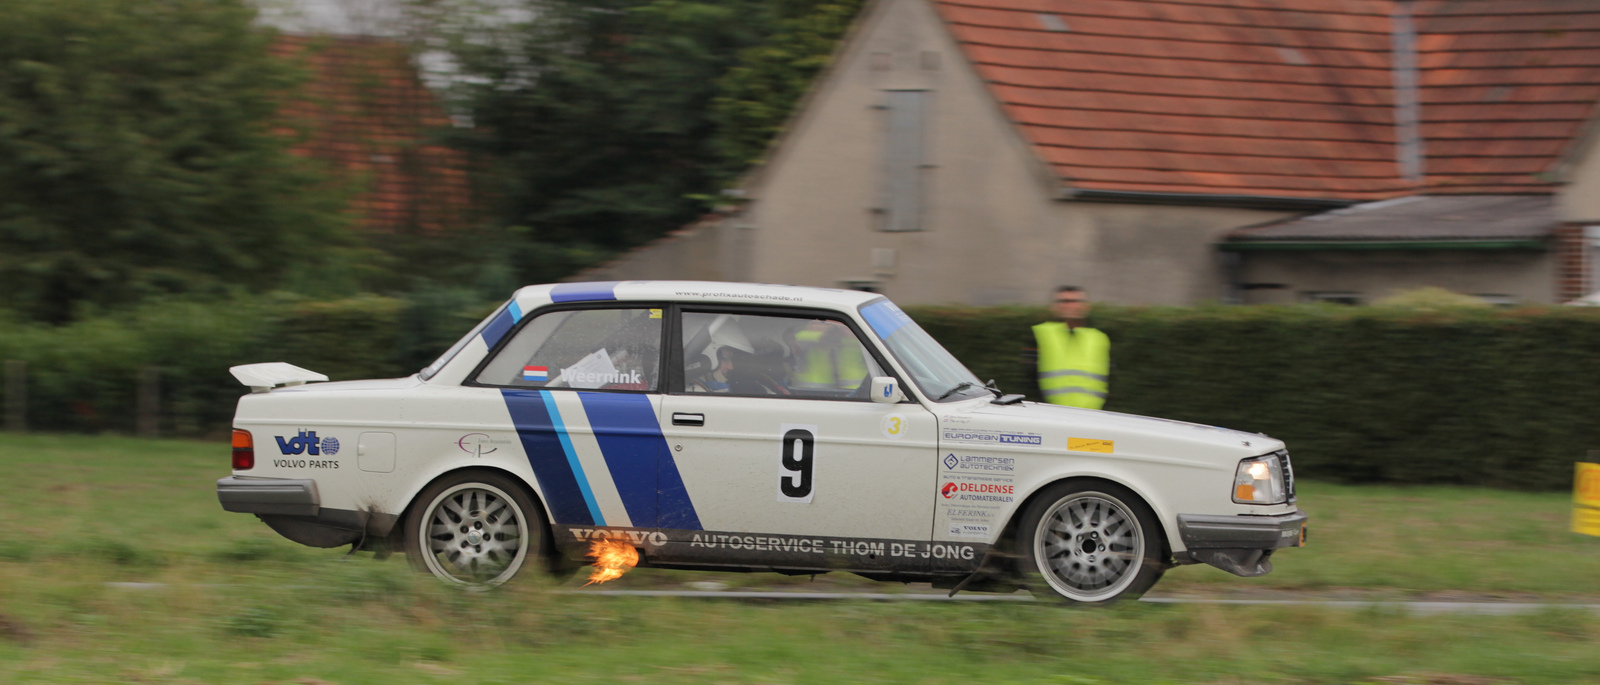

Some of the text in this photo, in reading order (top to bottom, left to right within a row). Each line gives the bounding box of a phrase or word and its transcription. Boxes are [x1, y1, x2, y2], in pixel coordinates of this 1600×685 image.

[675, 291, 803, 302] www.profixautoschade.nl
[560, 368, 641, 384] Weernink
[887, 416, 901, 435] 3
[1001, 434, 1041, 444] TUNING
[273, 459, 340, 470] VOLVO PARTS
[781, 429, 814, 498] 9
[960, 483, 1015, 495] DELDENSE
[960, 494, 1014, 503] AUTOMATERIALEN
[569, 528, 668, 547] VOLVO
[690, 534, 975, 560] AUTOSERVICE THOM DE JONG
